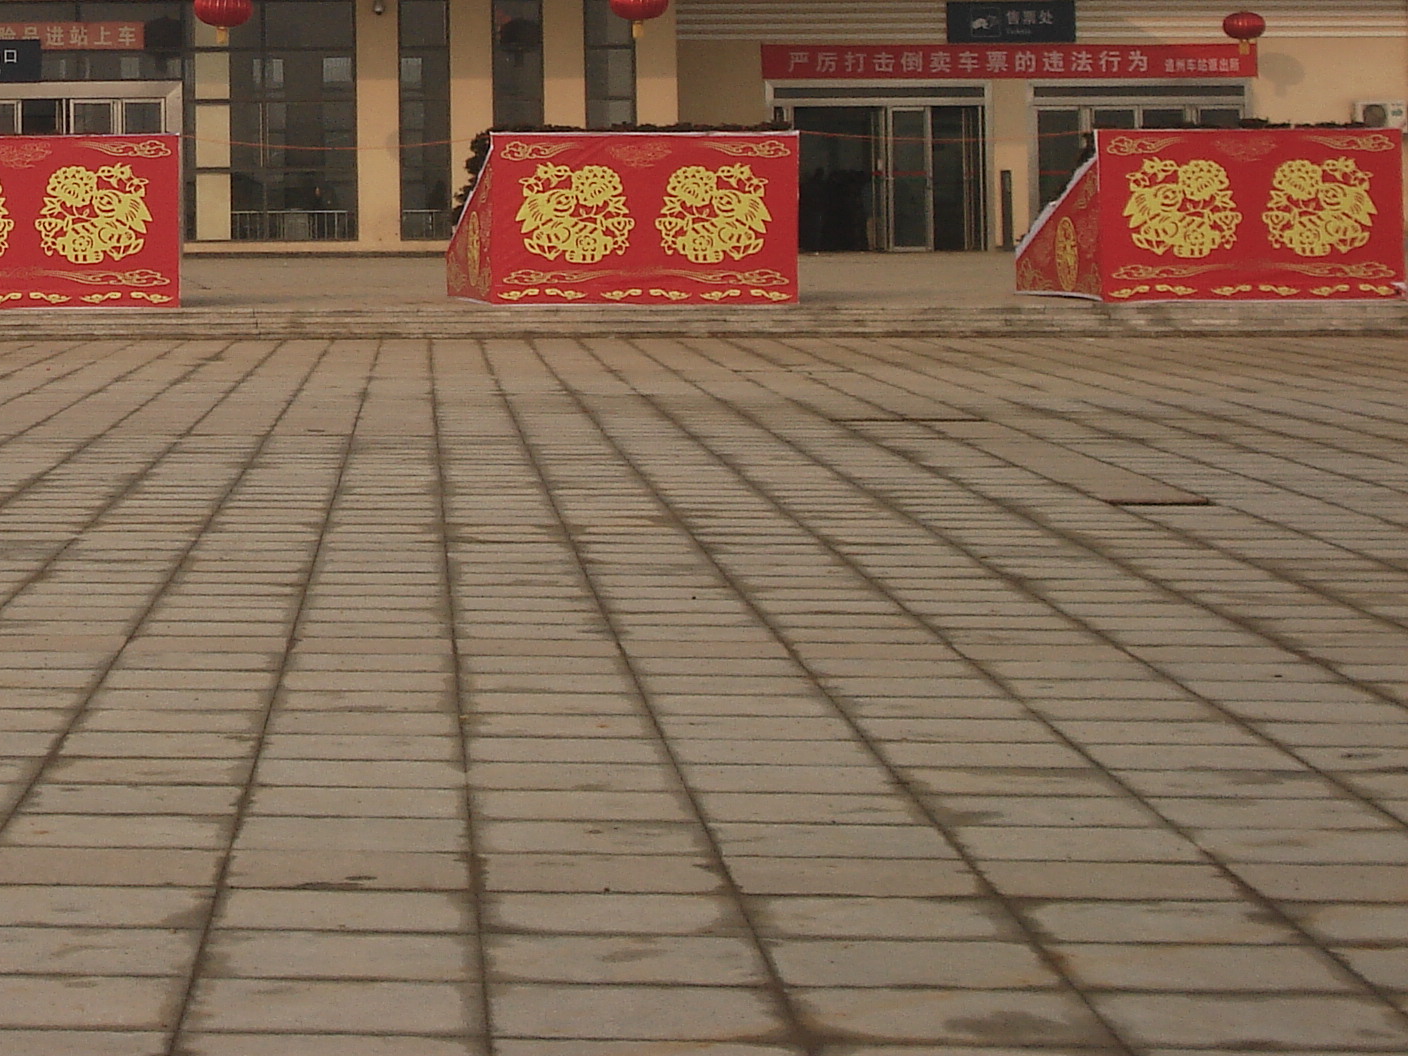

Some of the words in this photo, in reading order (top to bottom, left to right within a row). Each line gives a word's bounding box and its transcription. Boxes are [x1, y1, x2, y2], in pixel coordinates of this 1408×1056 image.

[1006, 10, 1053, 25] 售票处
[788, 50, 1149, 73] 严厉打击倒卖车票的违法行为
